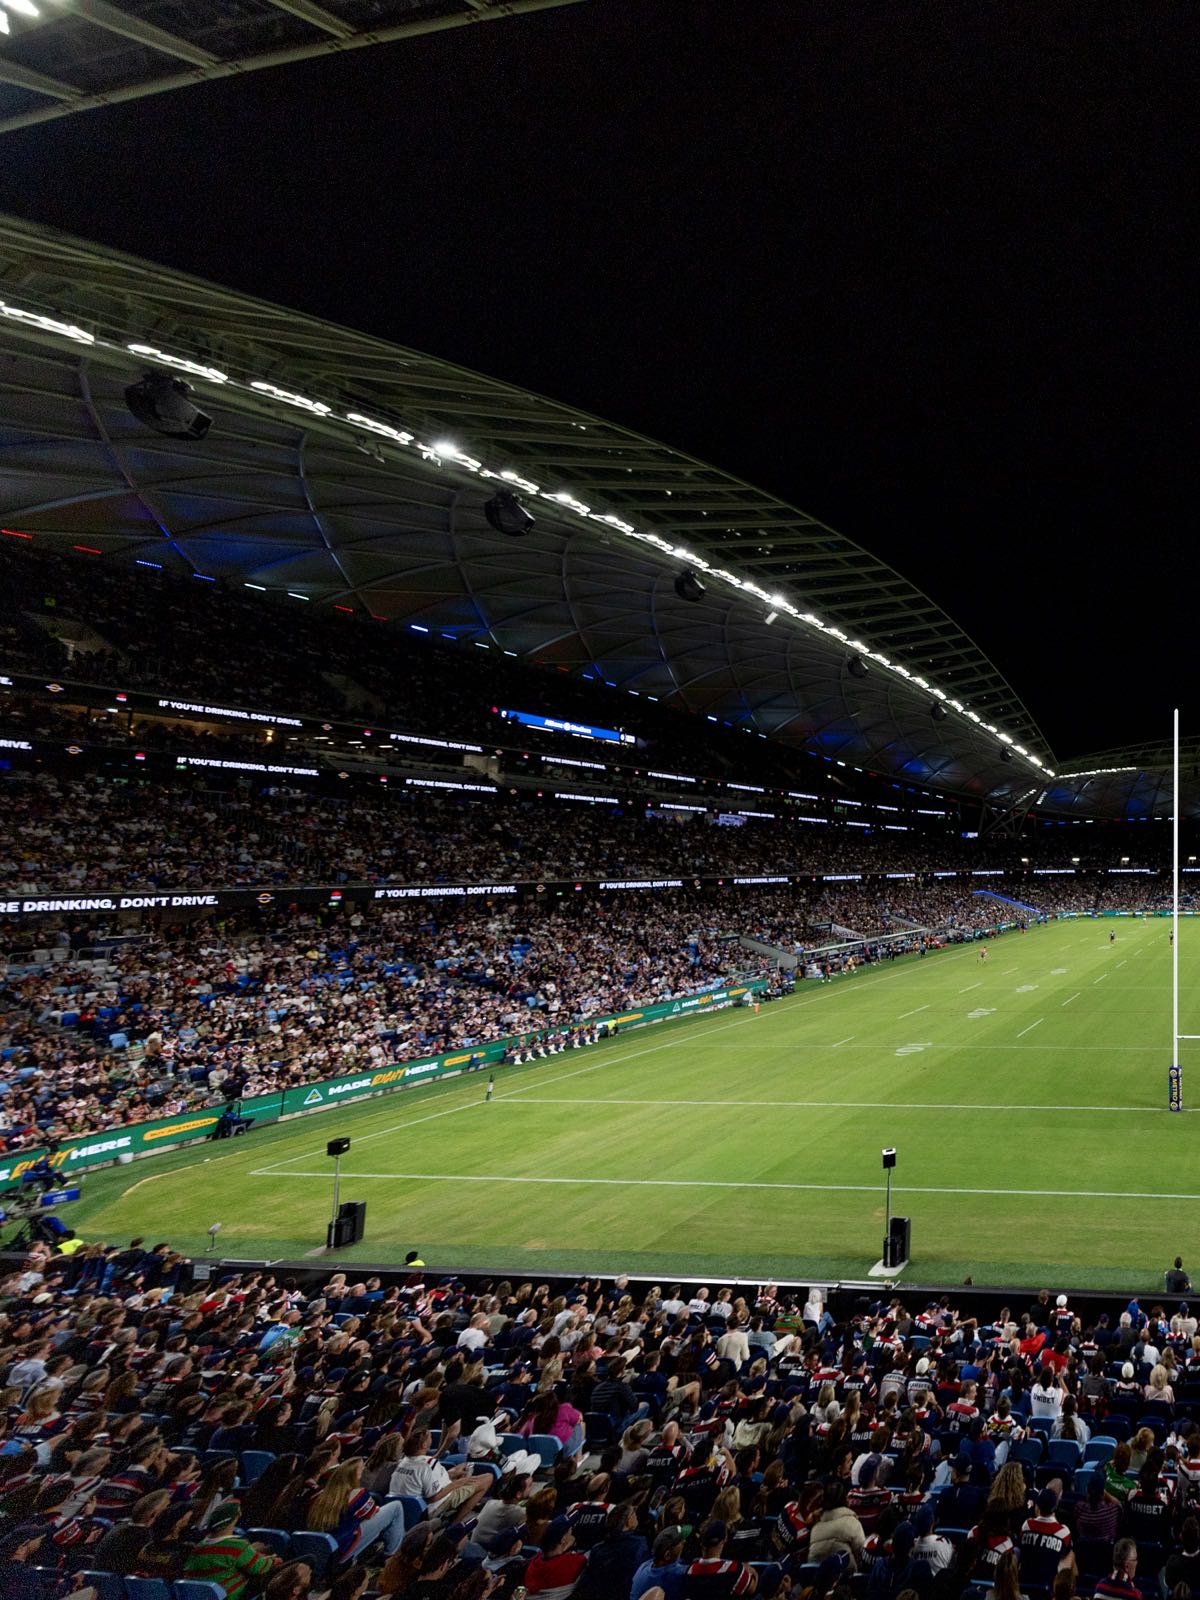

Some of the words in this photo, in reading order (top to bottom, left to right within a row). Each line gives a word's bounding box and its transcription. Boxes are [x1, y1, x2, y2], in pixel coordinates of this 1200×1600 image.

[170, 701, 204, 712] YOU'RE
[205, 706, 250, 719] DRINKING,
[251, 713, 276, 722] DON'T
[277, 718, 302, 726] DRIVE.
[188, 758, 221, 767] YOU'RE
[222, 760, 267, 771] DRINKING,
[386, 888, 420, 897] YOU'RE
[422, 888, 466, 896] DRINKING,
[23, 899, 117, 912] DRINKING,
[120, 897, 169, 908] DON'T
[172, 896, 219, 906] DRIVE.
[328, 1078, 371, 1095] MADE
[370, 1067, 408, 1086] RIGHT
[405, 1062, 438, 1076] HERE
[70, 1136, 131, 1160] HERE
[1033, 1393, 1055, 1404] UNIBET
[851, 1431, 873, 1440] UNIBE
[1131, 1502, 1164, 1515] UNIBET
[1022, 1530, 1038, 1546] CITY
[1040, 1532, 1062, 1552] FORD
